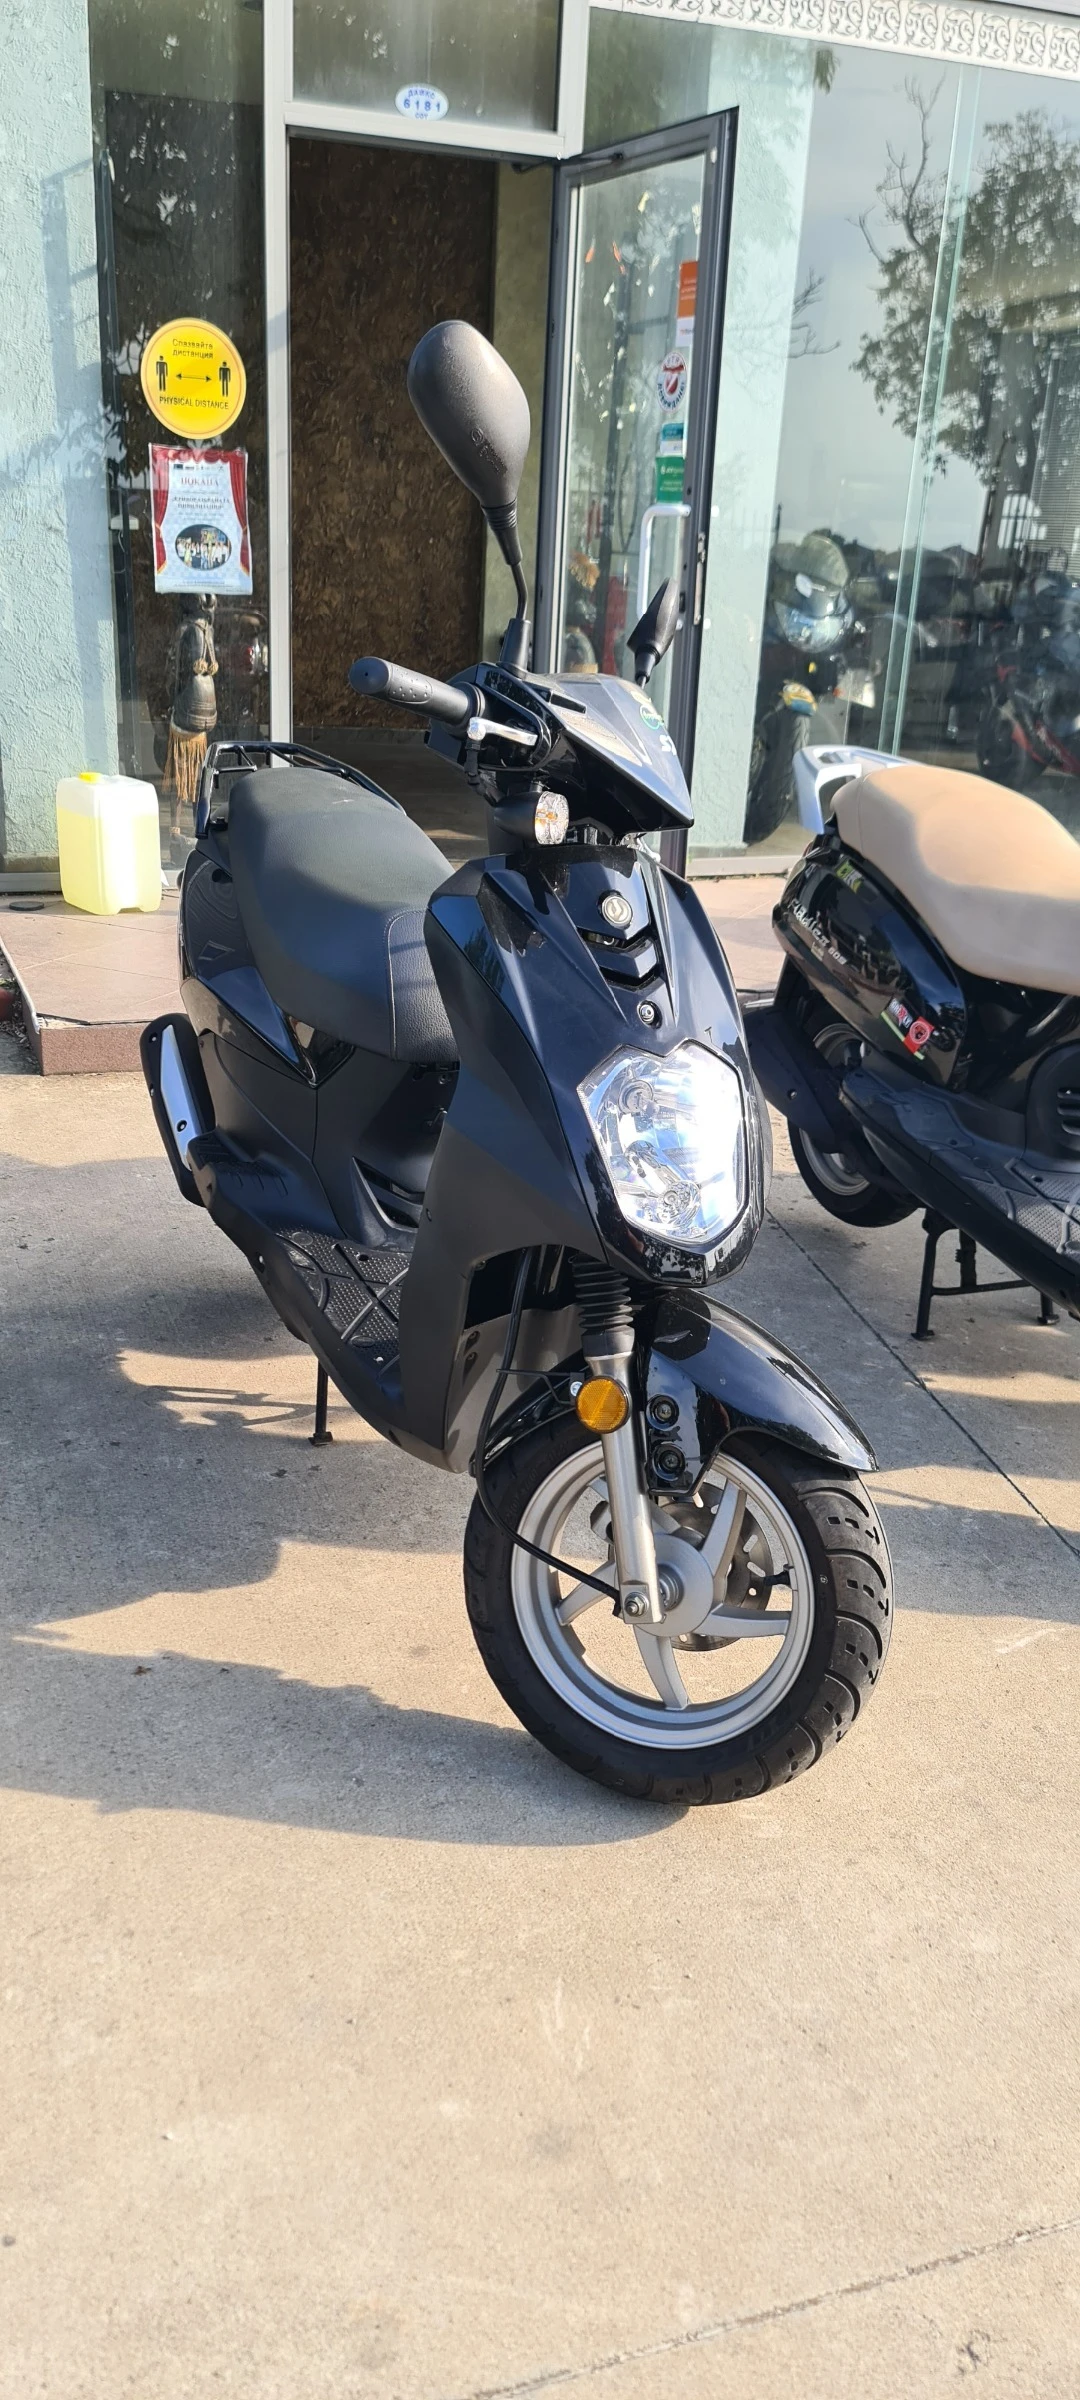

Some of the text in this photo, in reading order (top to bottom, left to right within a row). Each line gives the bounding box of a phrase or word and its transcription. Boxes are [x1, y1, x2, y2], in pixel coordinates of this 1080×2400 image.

[404, 99, 440, 112] 6181
[172, 338, 213, 350] Спазвайте
[172, 349, 214, 359] дистанция
[160, 396, 229, 410] PHYSICAL DISTANCE
